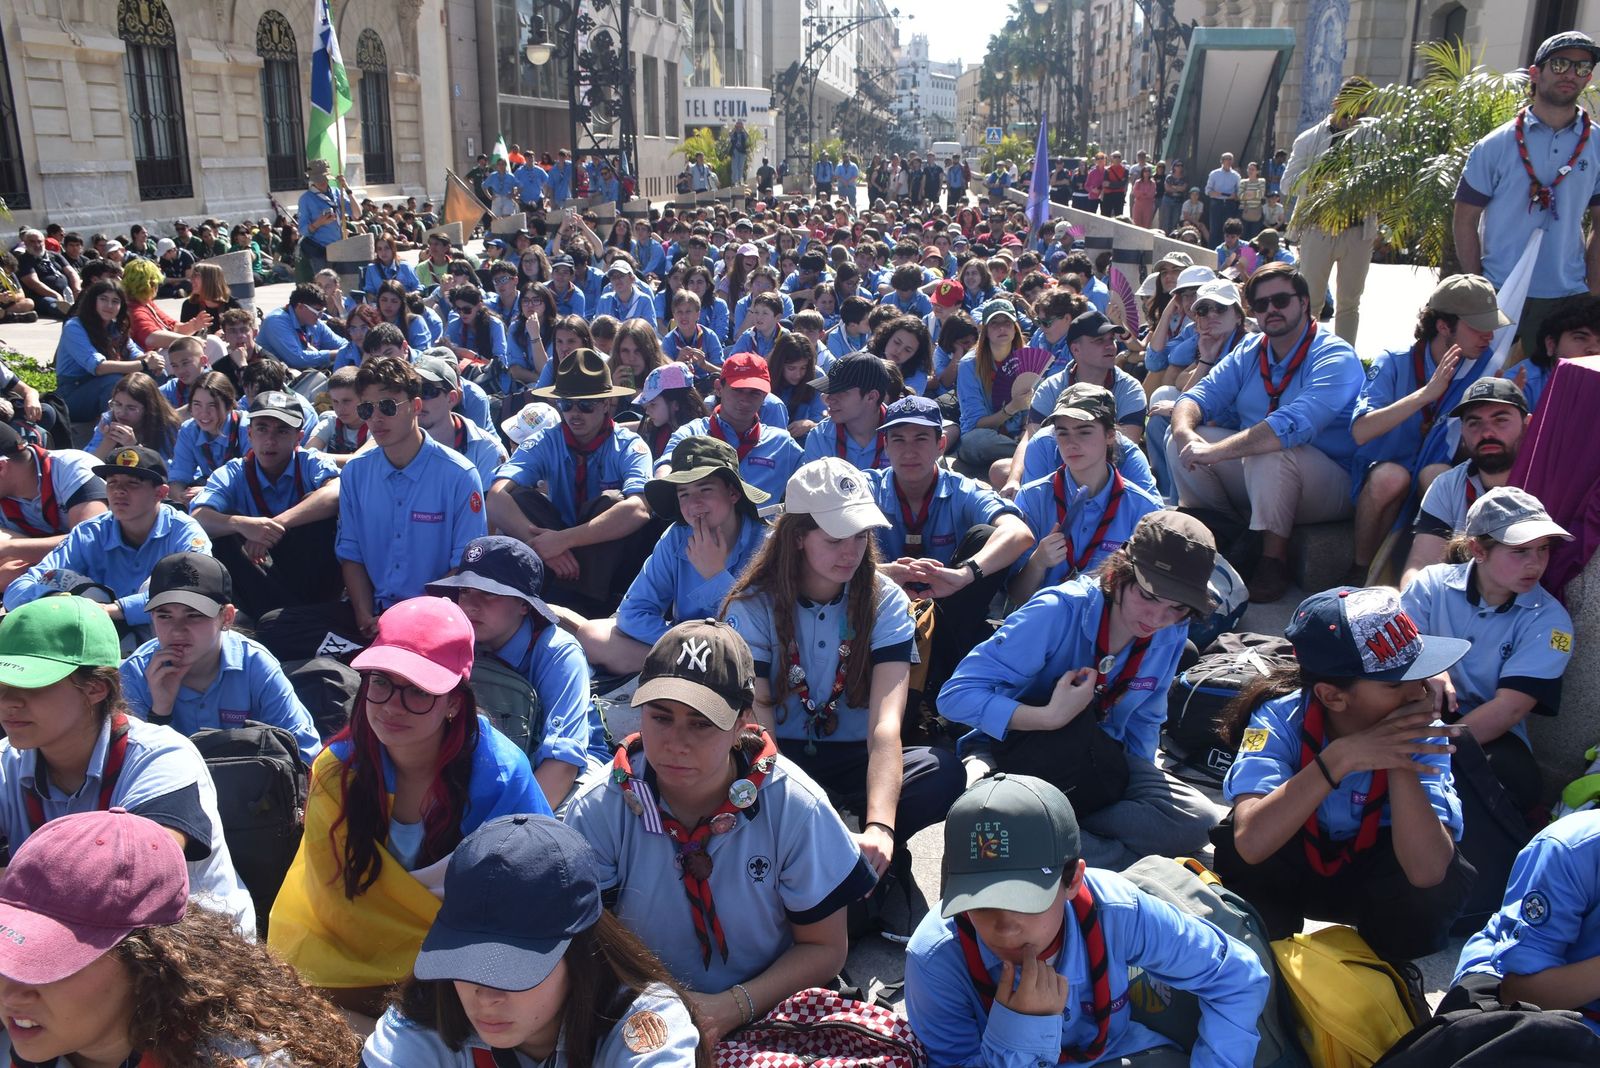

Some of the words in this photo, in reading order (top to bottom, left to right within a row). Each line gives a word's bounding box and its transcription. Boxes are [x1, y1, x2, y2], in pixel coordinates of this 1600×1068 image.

[714, 99, 748, 118] CEUTA
[676, 636, 712, 673] NY
[1365, 610, 1420, 664] MAR
[0, 660, 25, 672] EUTA
[975, 821, 1001, 832] GET
[1000, 829, 1009, 858] OUT!
